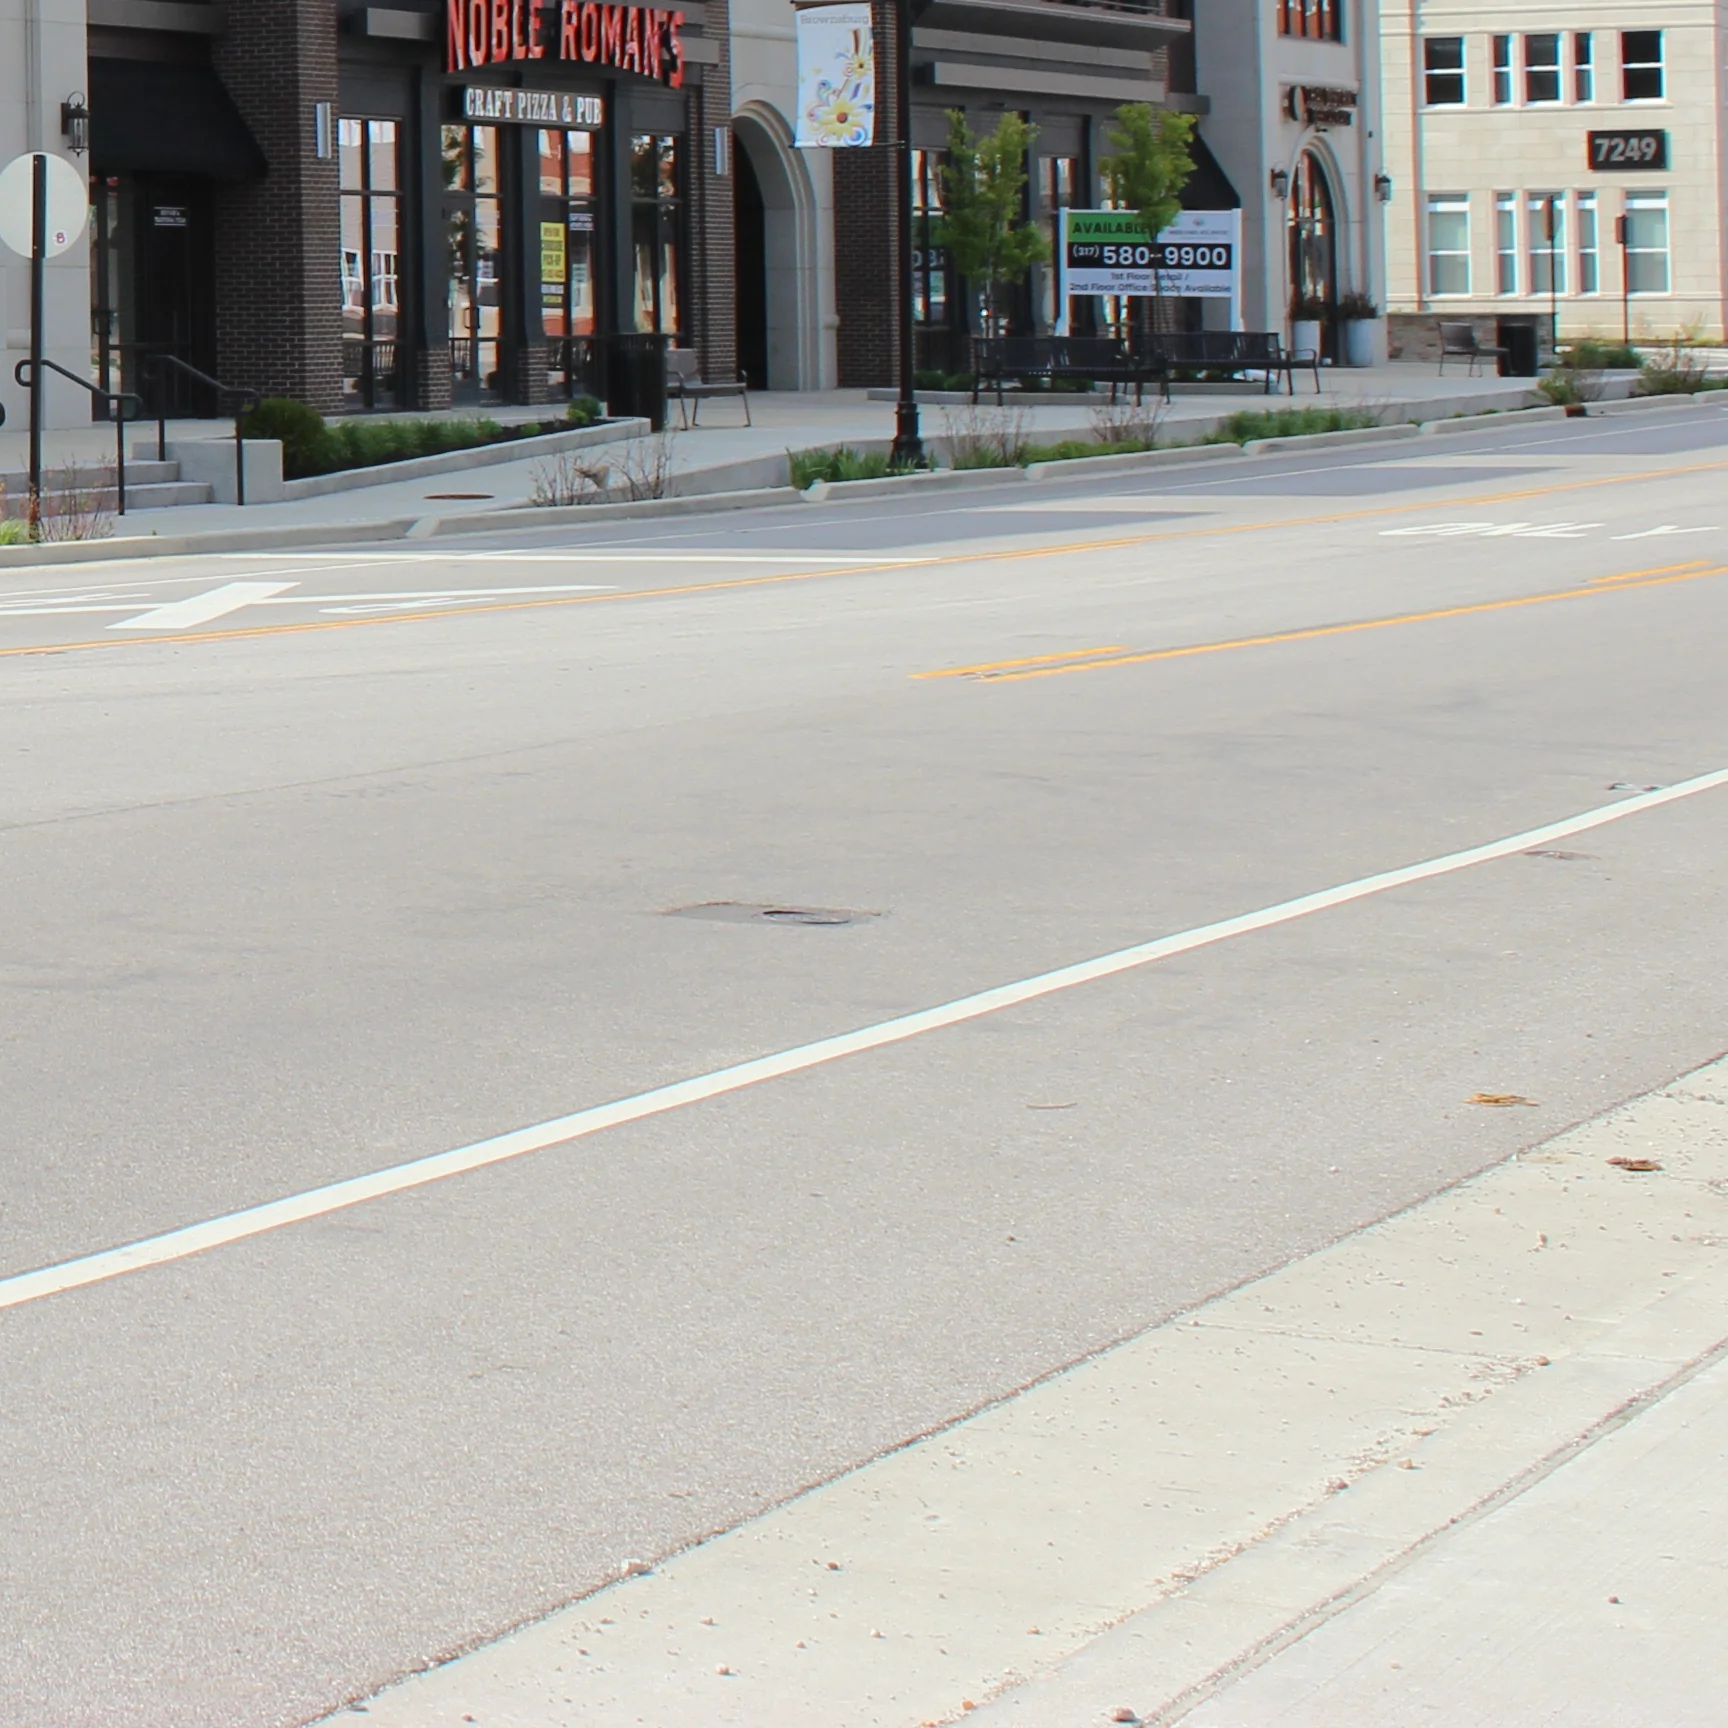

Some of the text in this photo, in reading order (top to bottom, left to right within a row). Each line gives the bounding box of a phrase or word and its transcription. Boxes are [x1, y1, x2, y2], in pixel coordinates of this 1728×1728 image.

[559, 0, 686, 89] ROMAN'S
[465, 88, 603, 125] CRAFT PIZZA & PUB
[1594, 136, 1657, 161] 7249
[1072, 244, 1227, 265] (317) 580-9900
[1091, 284, 1115, 292] Floor
[1118, 284, 1148, 292] Office
[1127, 273, 1151, 281] Floor
[1152, 273, 1182, 281] etail
